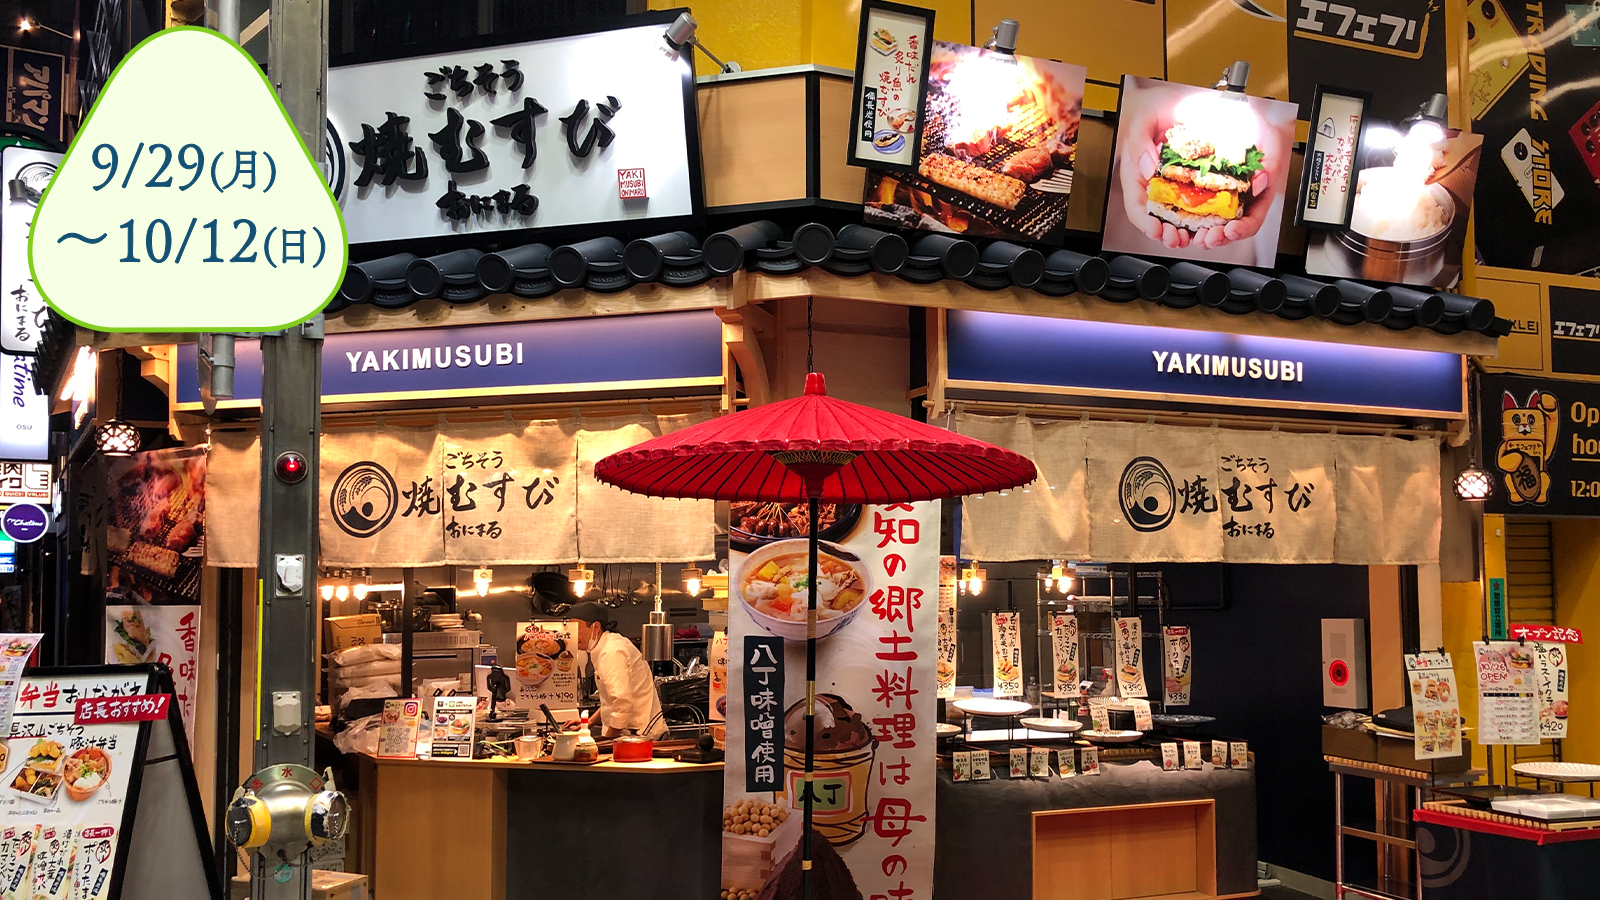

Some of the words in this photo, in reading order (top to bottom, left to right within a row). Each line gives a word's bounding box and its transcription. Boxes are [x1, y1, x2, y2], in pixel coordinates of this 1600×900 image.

[905, 35, 919, 84] 香味だれ
[424, 60, 524, 100] ごちそう
[876, 71, 892, 118] 焼むすび
[349, 96, 622, 187] 焼むすび
[619, 170, 642, 179] YAKI
[1531, 138, 1552, 225] STORE
[436, 180, 539, 220] おにまる
[10, 285, 31, 342] おにまる
[346, 342, 524, 373] YAKIMUSUBI
[1152, 351, 1304, 383] YAKIMUSUBI
[445, 450, 504, 470] ごちそう
[1220, 455, 1270, 474] ごちそう
[401, 471, 560, 521] 焼むすび
[1178, 474, 1315, 515] 焼むすび
[445, 516, 503, 540] おにまる
[1222, 516, 1275, 540] おにまる
[1514, 626, 1579, 641] オープン記念
[1480, 662, 1507, 672] 10/26
[750, 644, 779, 784] 八丁味噌使用
